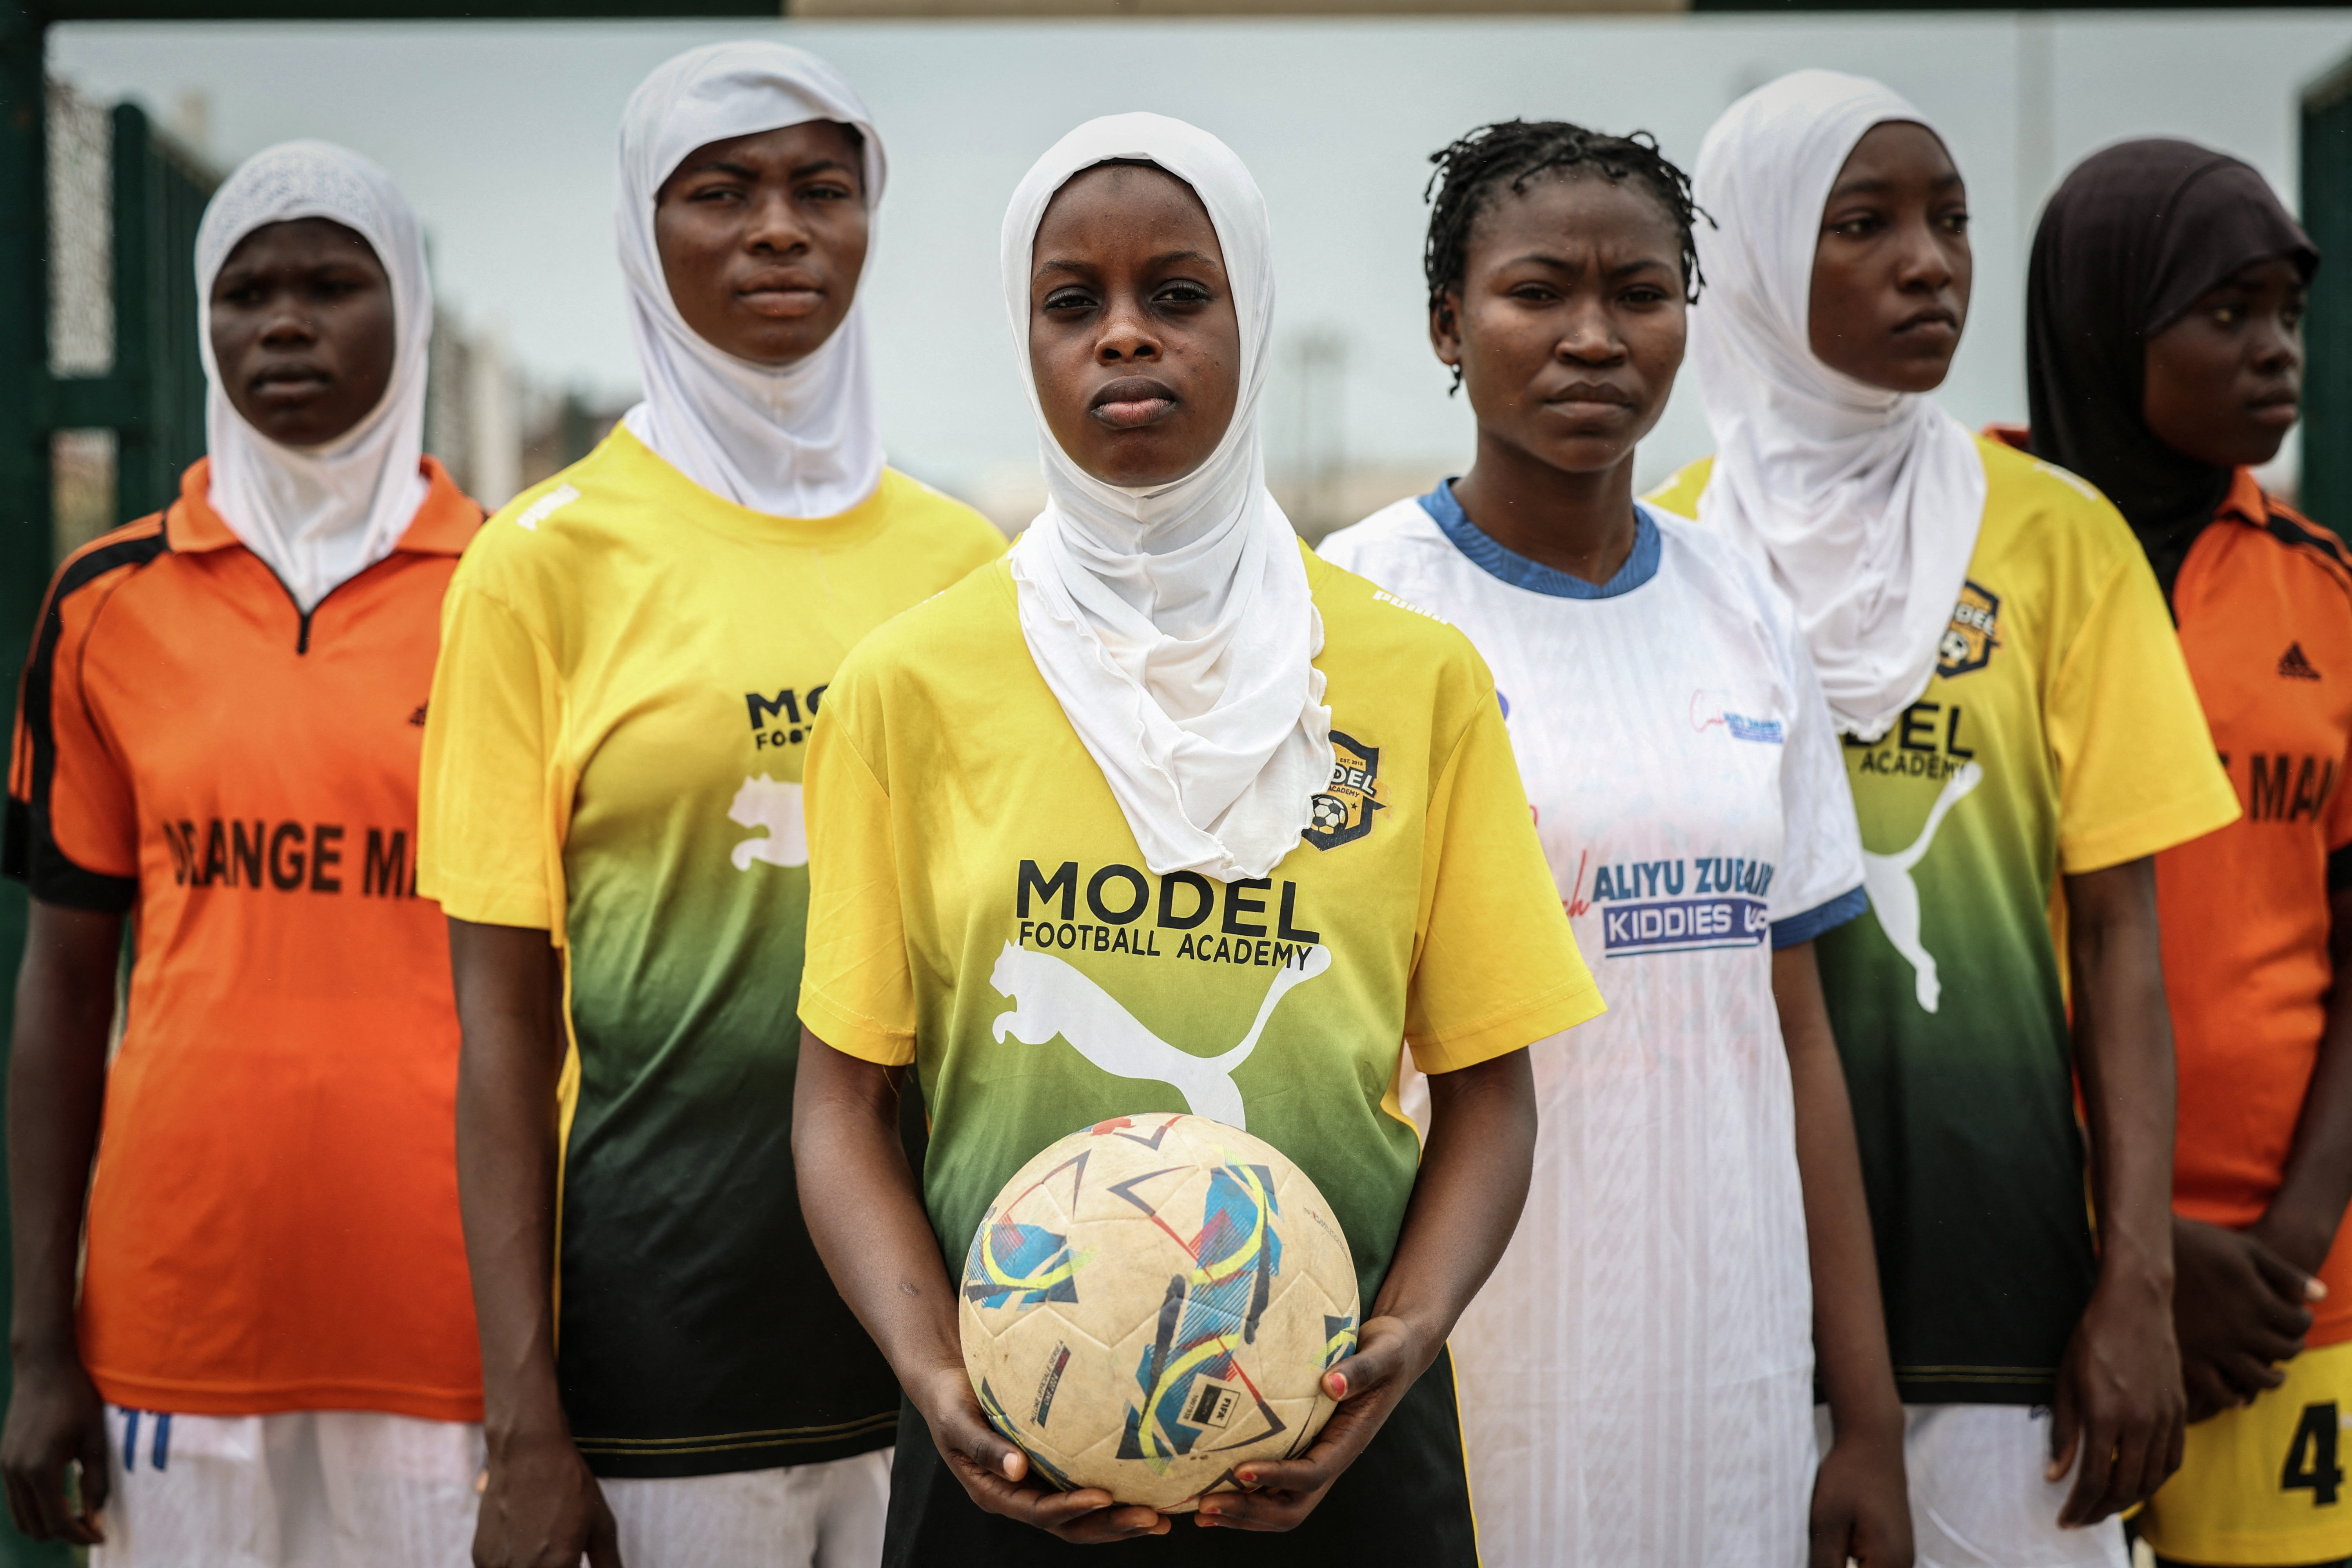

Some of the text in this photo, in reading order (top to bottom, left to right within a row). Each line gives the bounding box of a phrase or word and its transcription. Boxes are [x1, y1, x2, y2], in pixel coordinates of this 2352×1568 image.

[1955, 603, 1994, 637] DEL
[1844, 701, 1974, 758] EL
[1331, 765, 1374, 795] DEL
[363, 826, 417, 898] M
[1593, 860, 1684, 902] ALIYU
[1017, 860, 1319, 944] MODEL
[1609, 904, 1732, 942] KIDDIES
[1019, 922, 1312, 971] FOOTBALL ACADEMY
[1216, 1397, 1232, 1421] FIFA
[2280, 1401, 2343, 1507] 4
